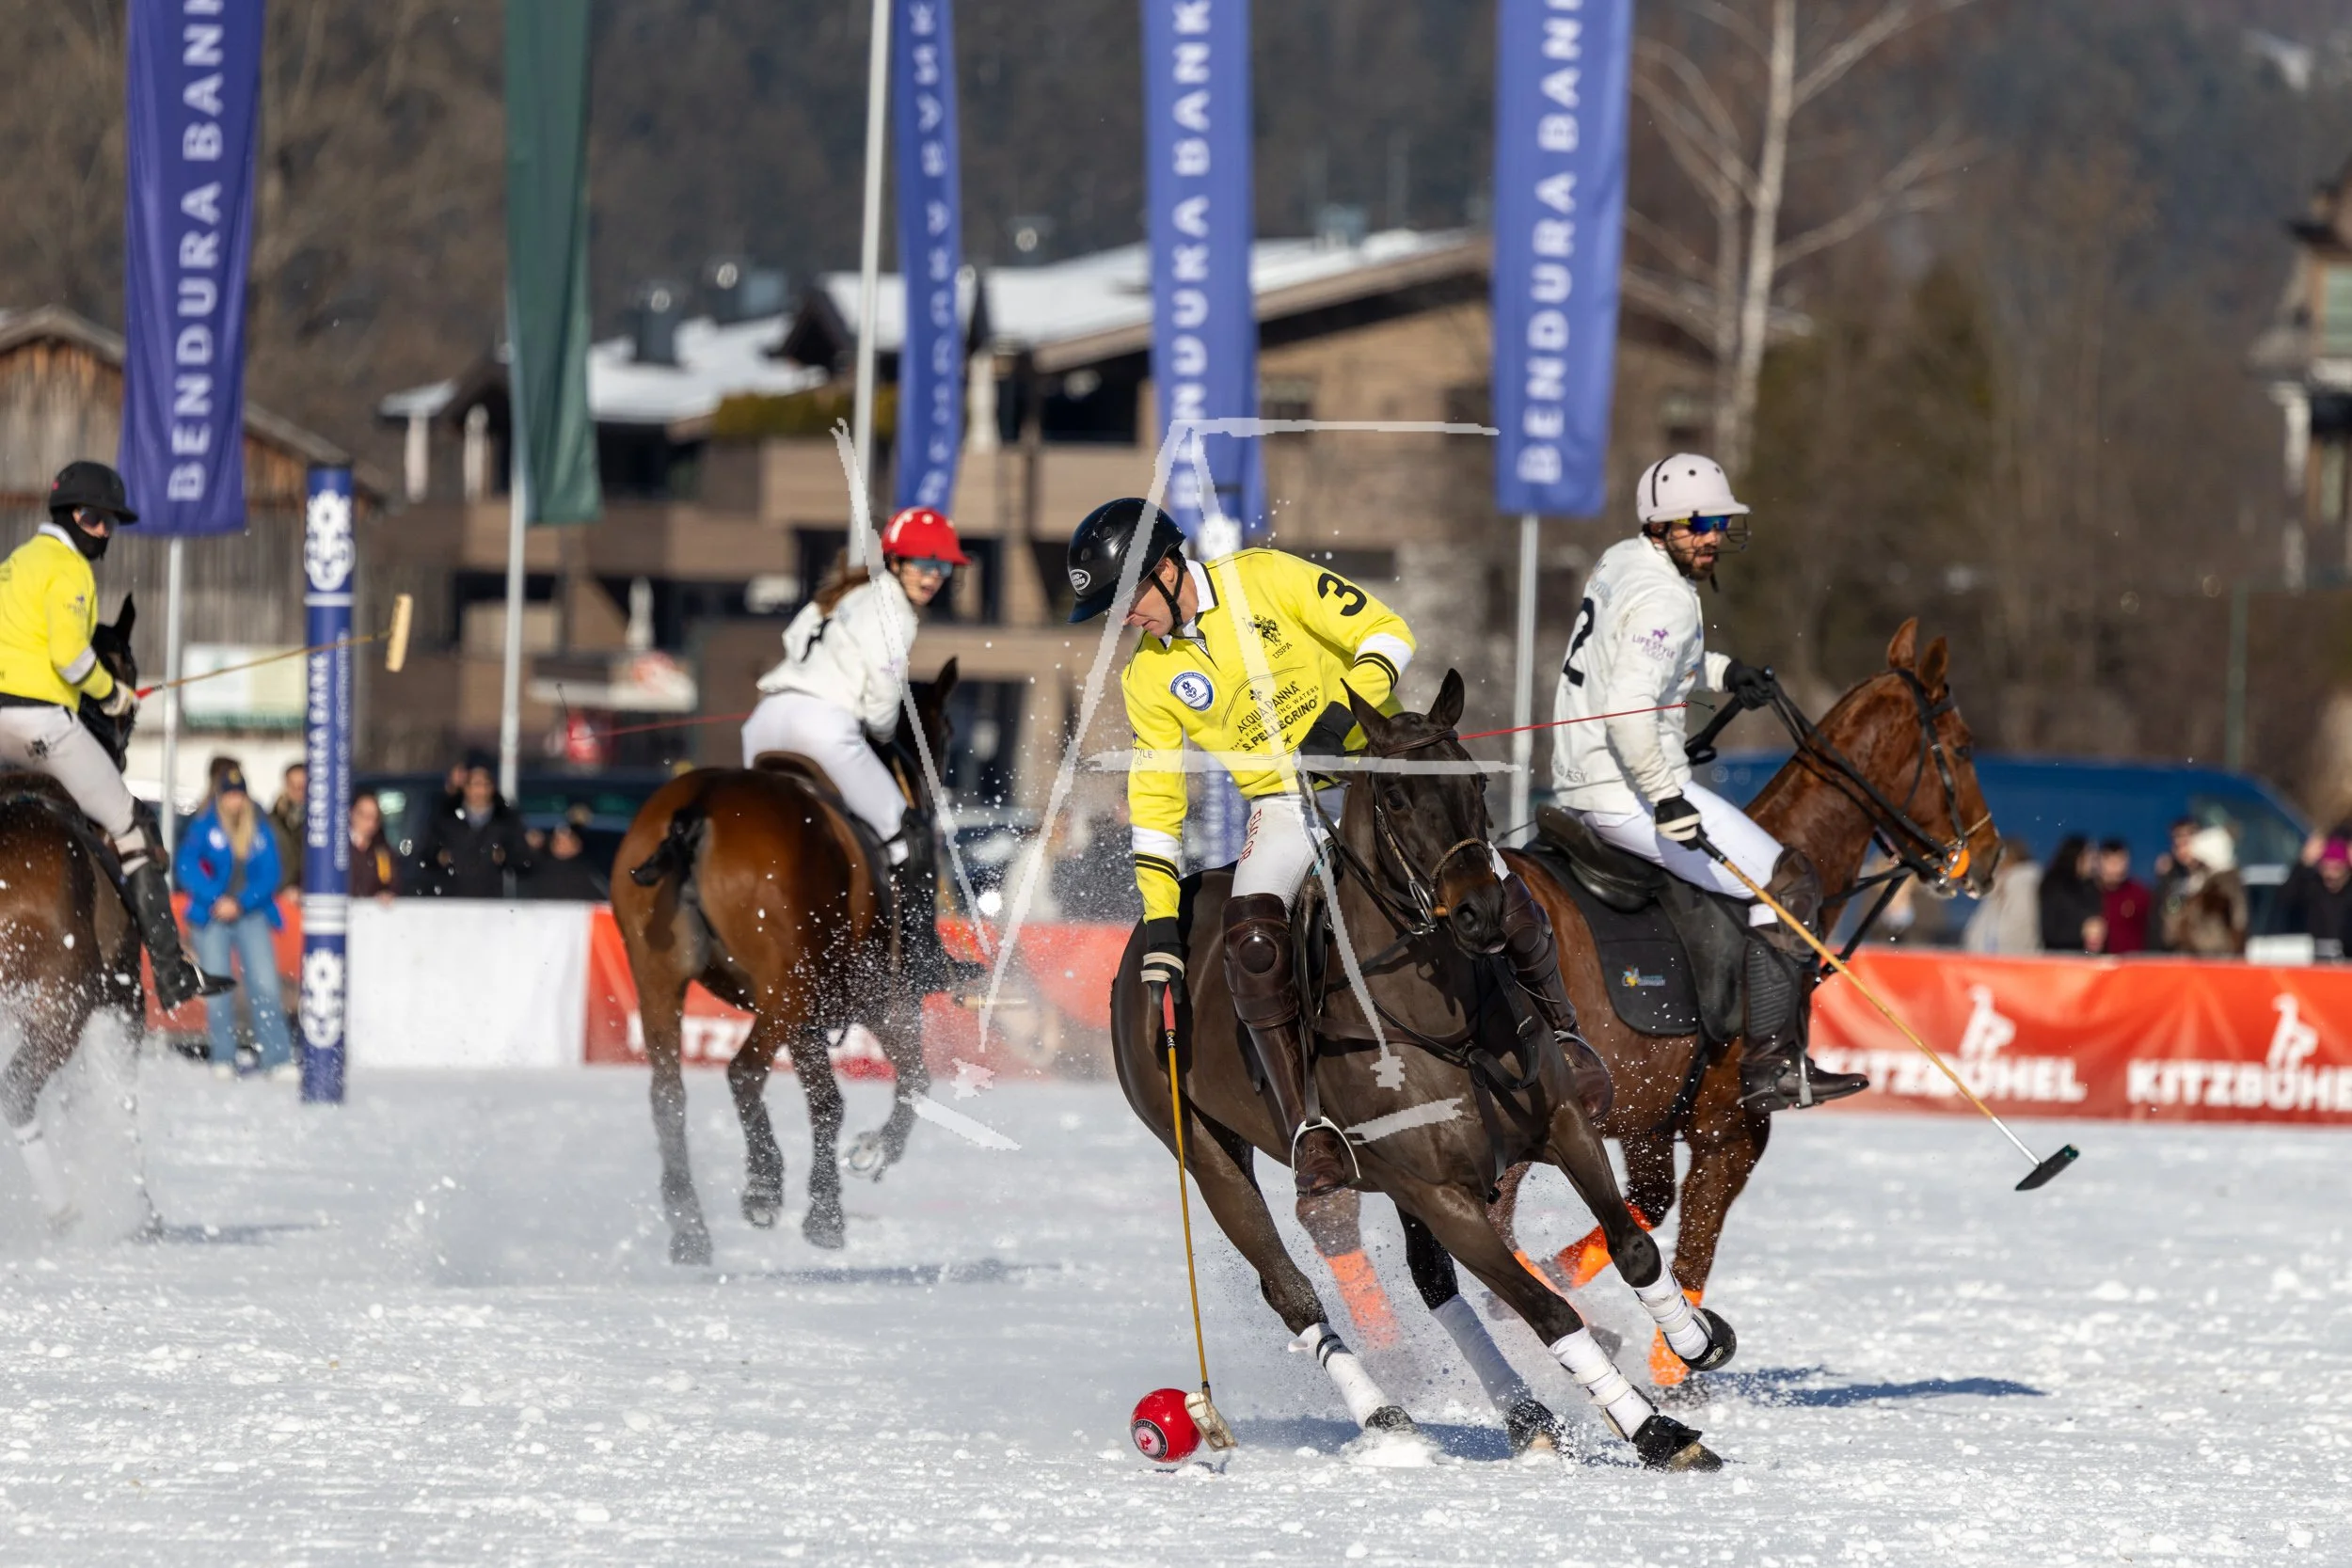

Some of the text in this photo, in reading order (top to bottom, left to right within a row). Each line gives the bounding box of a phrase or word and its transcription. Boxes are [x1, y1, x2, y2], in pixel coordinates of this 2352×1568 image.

[1172, 0, 1212, 177] BANK
[1517, 0, 1583, 484] BENDURA BAN
[167, 182, 222, 502] BENDURA
[1318, 573, 1367, 617] 3
[1272, 641, 1293, 659] USPA
[1563, 597, 1595, 689] 2
[1632, 633, 1676, 659] LIFESTYLE
[308, 653, 330, 847] BENDURA BANK
[1231, 685, 1319, 752] THE FINE DINING WATERS
[1237, 706, 1268, 734] ACQUA
